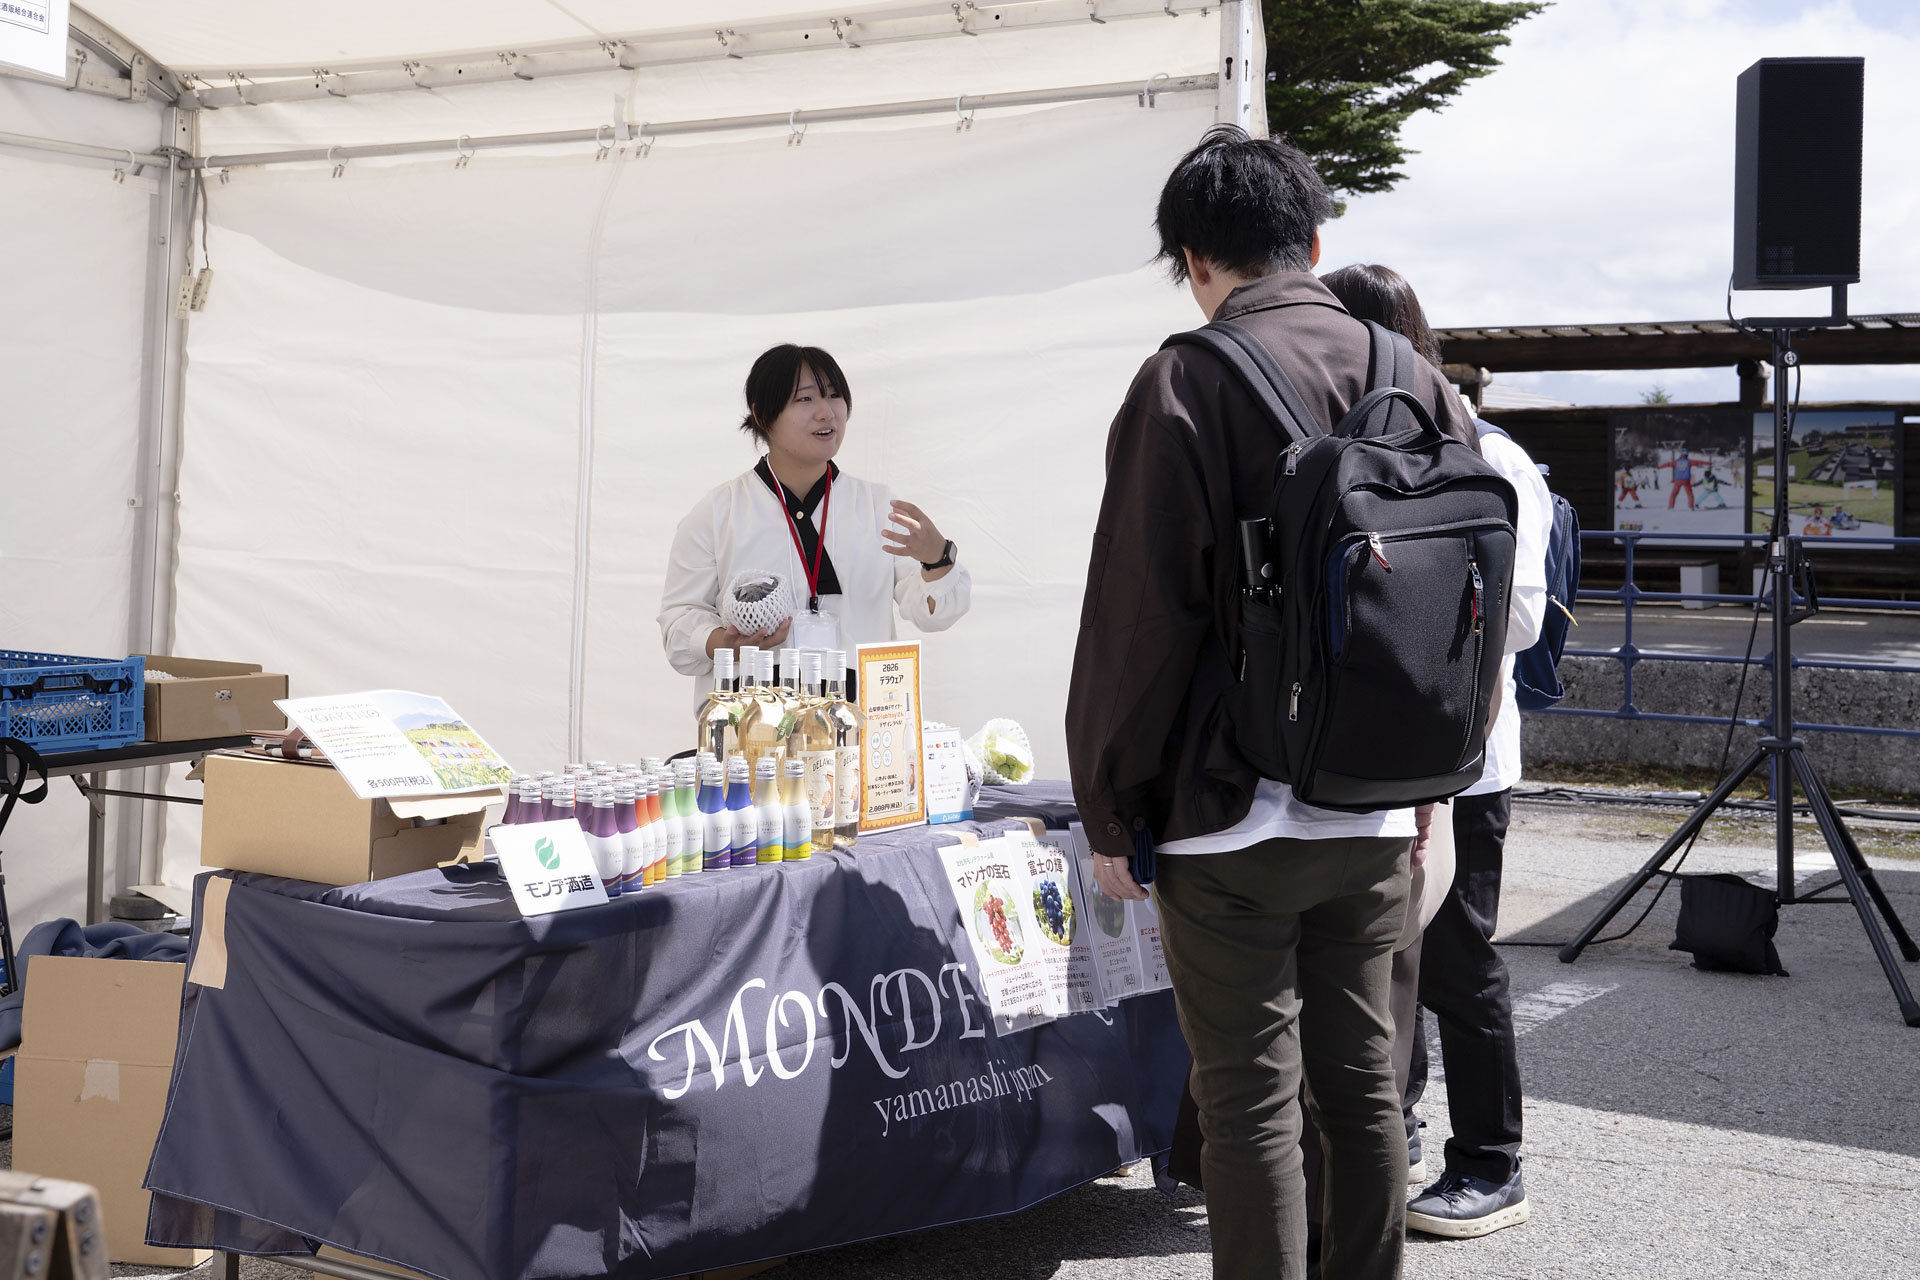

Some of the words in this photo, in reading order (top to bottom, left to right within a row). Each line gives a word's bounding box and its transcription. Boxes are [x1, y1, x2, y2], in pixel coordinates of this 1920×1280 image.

[0, 2, 45, 23] 酒販組合連合会
[879, 674, 904, 685] デラウェア
[367, 775, 433, 789] 各500円(税込)
[957, 863, 1011, 889] マドンナの宝石
[1027, 857, 1064, 877] 富士の輝
[524, 874, 595, 898] モンデ酒造
